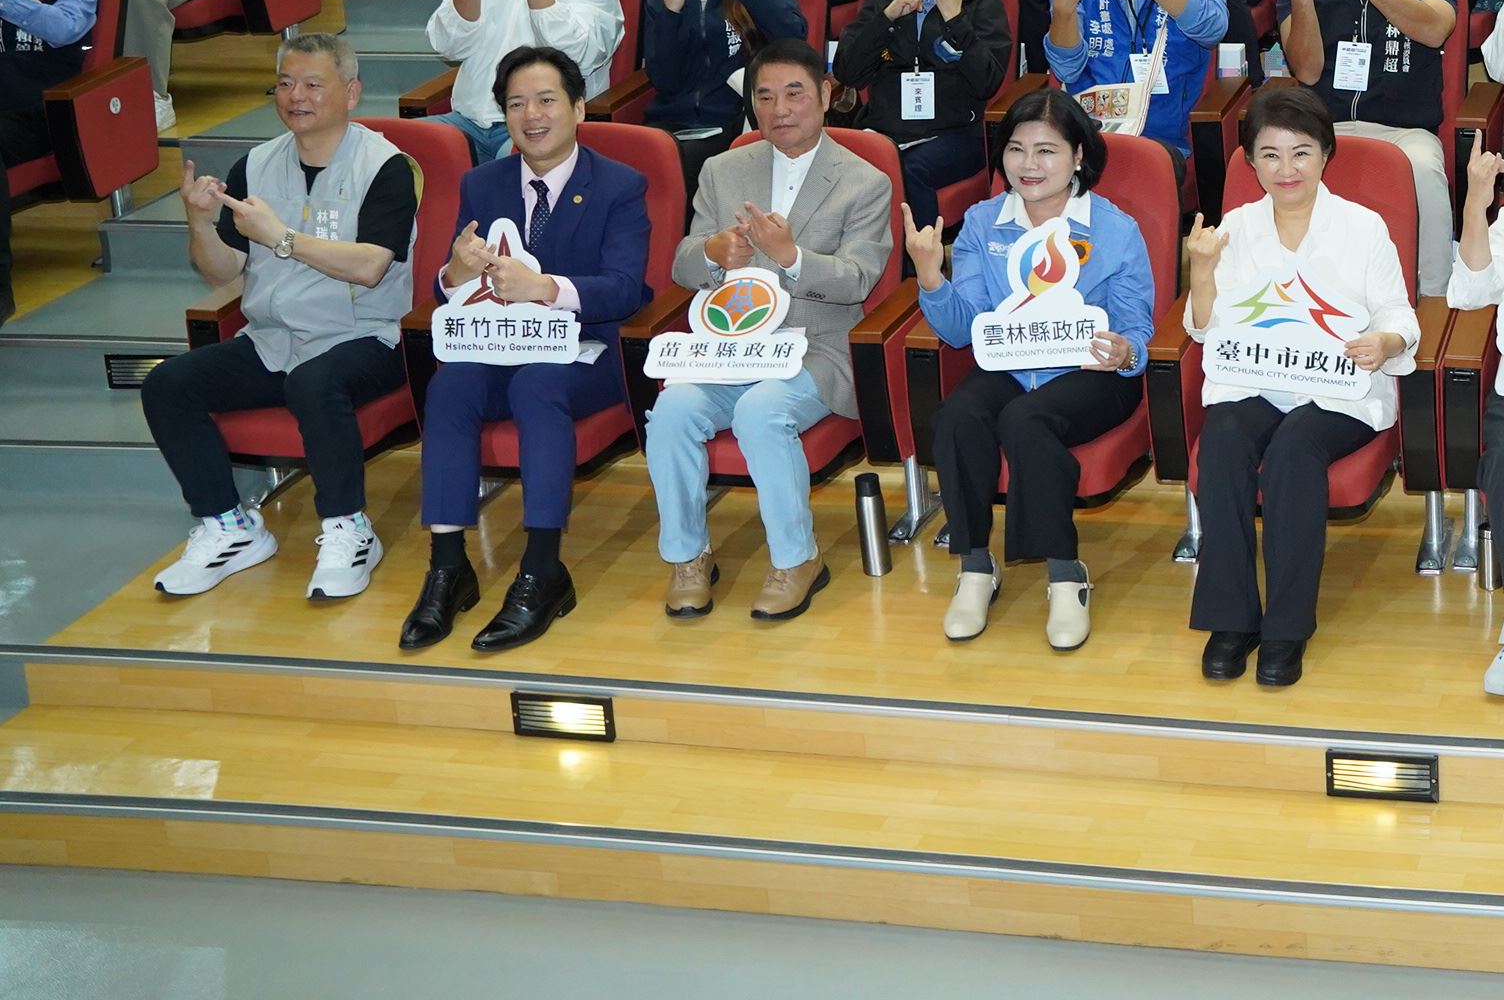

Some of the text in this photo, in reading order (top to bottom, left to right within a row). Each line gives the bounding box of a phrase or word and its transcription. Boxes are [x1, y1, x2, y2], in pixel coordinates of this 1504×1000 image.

[1383, 24, 1400, 73] 林鼎超
[914, 88, 923, 112] 來賓證
[444, 316, 569, 340] 新竹市政府
[982, 317, 1096, 347] 雲林縣政府
[445, 342, 568, 354] Hsinchu City Government
[658, 340, 796, 359] 苗栗縣政府
[986, 346, 1091, 359] YUNLIN COUNTY GOVERNME
[1215, 338, 1357, 377] 臺中市政府
[656, 360, 790, 371] Miaoli County Government
[1216, 364, 1358, 387] TAICHUNG CITY GOVERNMENT
